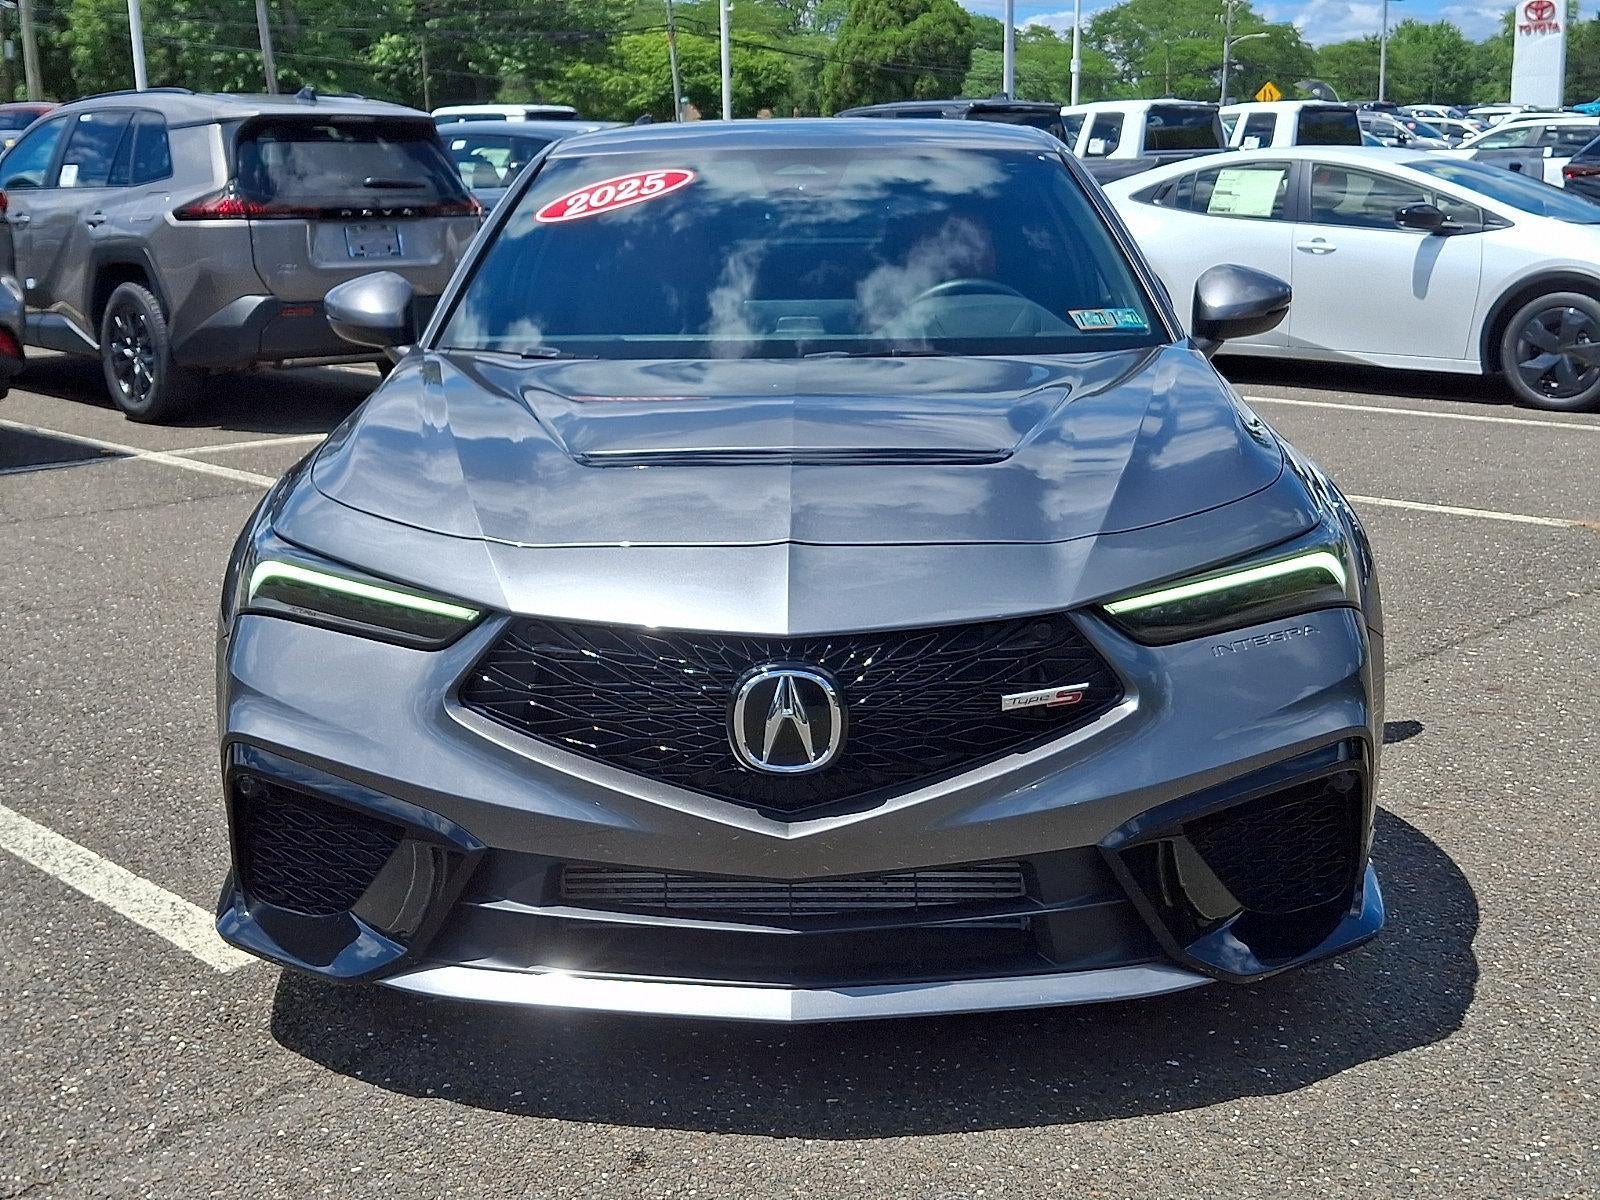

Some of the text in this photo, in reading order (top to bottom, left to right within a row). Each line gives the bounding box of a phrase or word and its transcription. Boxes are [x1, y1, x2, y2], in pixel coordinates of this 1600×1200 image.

[1519, 22, 1560, 36] TOYOTA
[563, 173, 667, 217] 2025
[1211, 625, 1321, 657] INTEGRA
[1009, 690, 1083, 708] Type S
